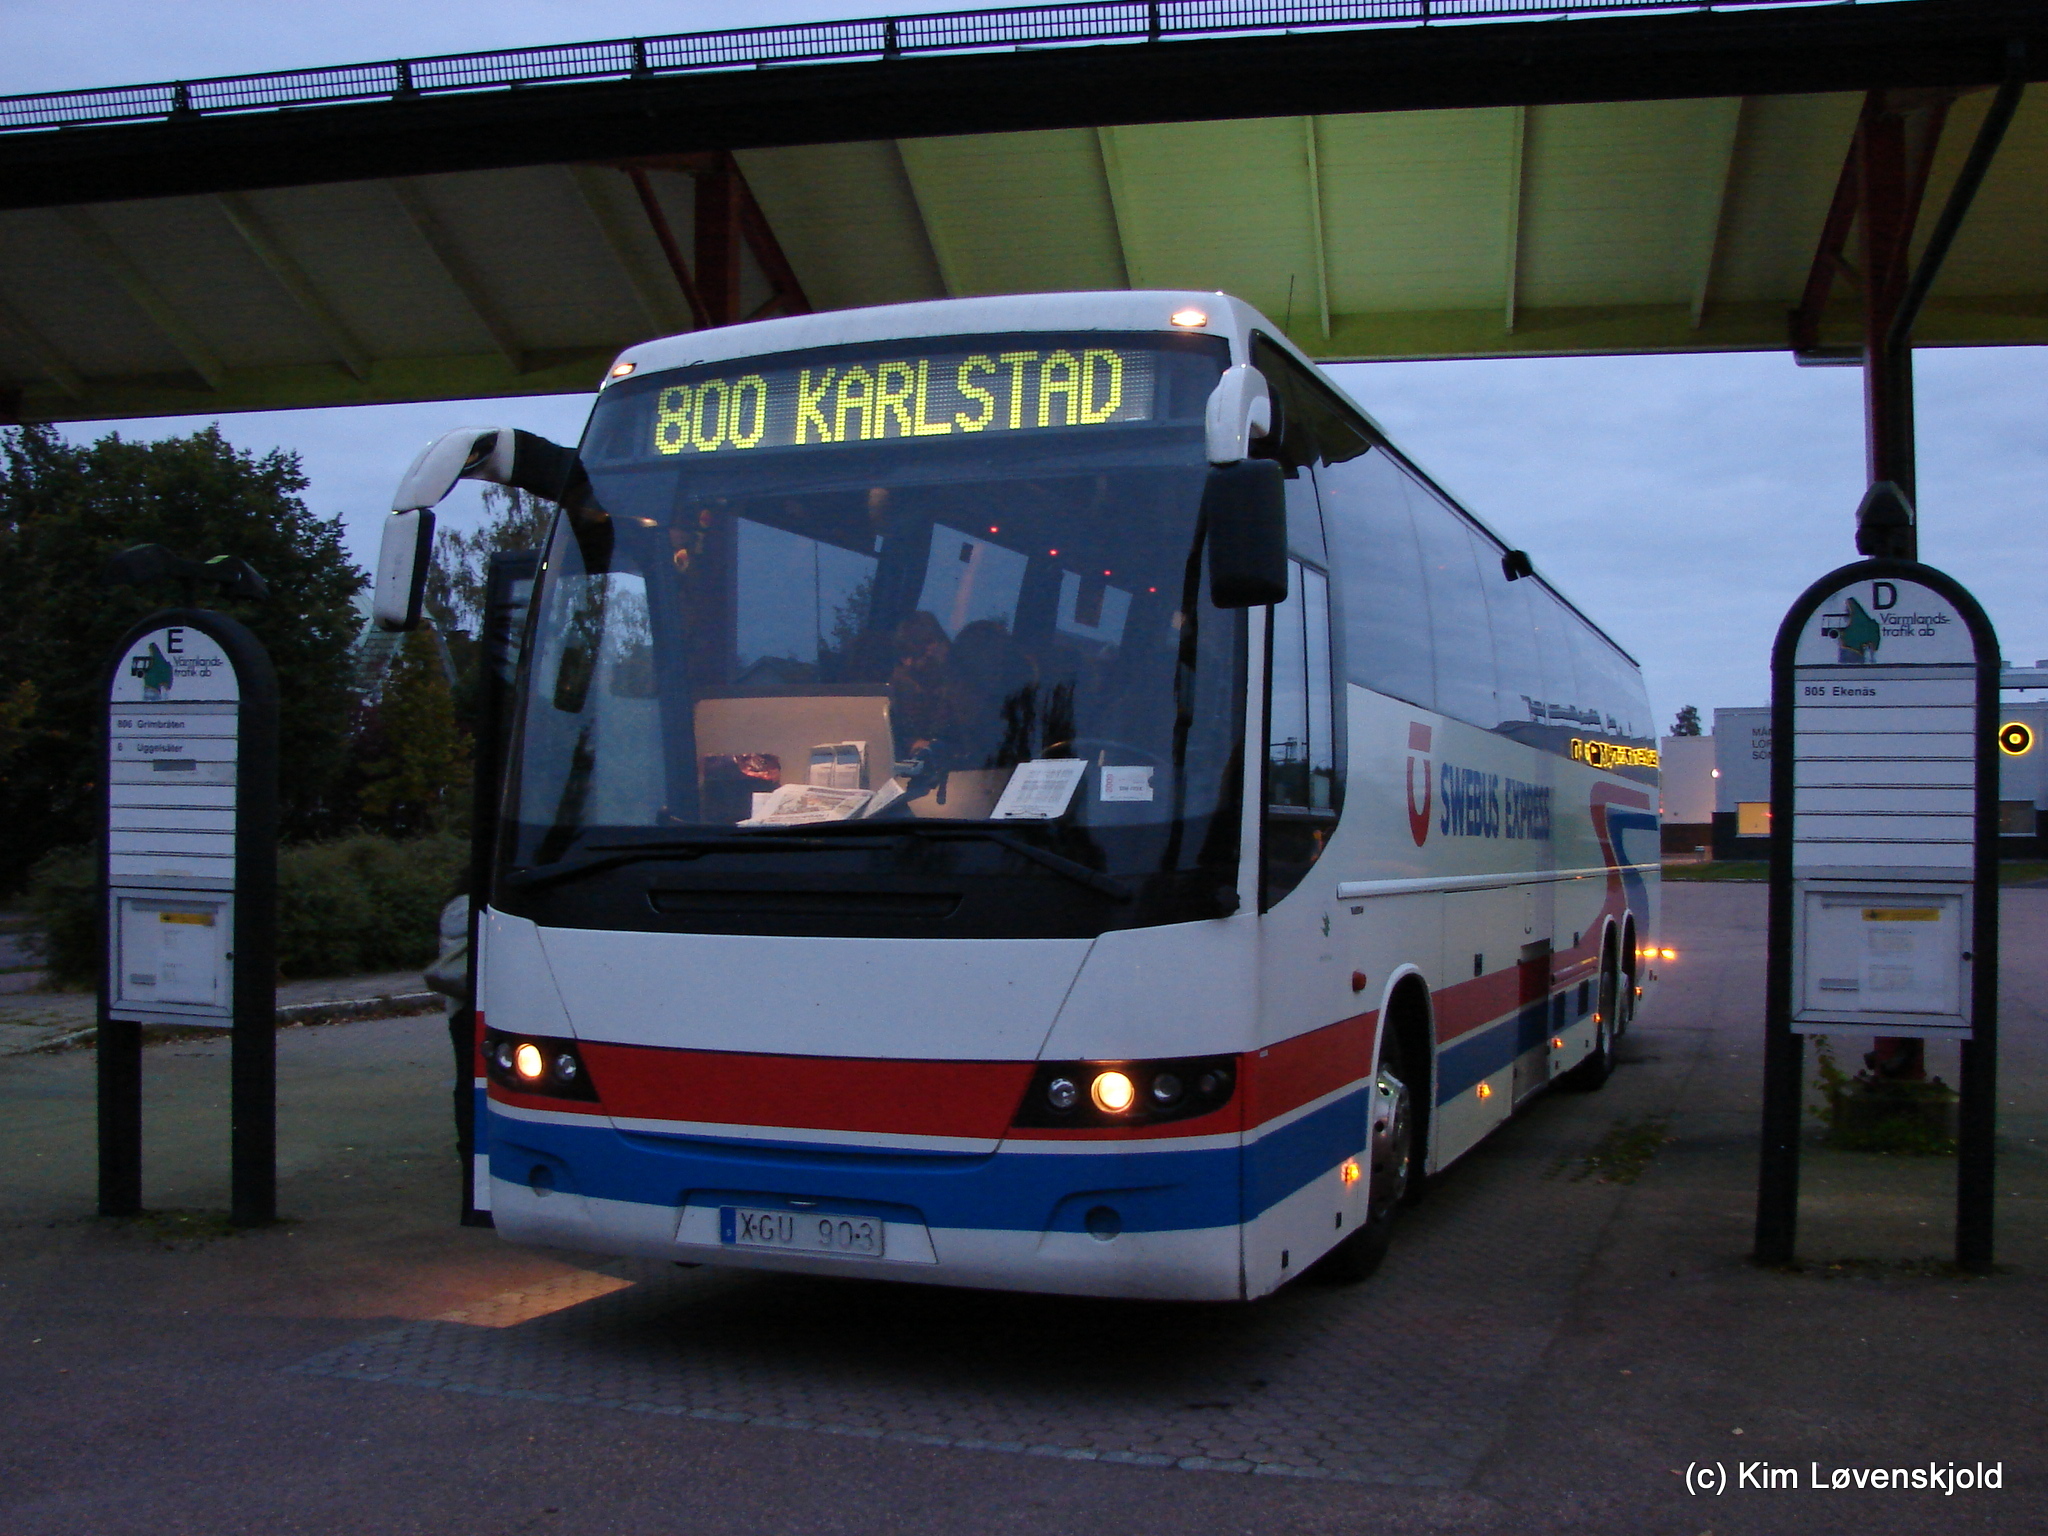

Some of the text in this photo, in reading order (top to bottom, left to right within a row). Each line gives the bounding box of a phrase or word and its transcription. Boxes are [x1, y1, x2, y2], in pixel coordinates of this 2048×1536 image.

[655, 348, 1122, 456] 800 KARLSTAD
[1872, 581, 1898, 610] D
[1879, 612, 1951, 624] Värmlands-
[1882, 625, 1935, 637] trafik ab
[167, 628, 184, 654] E
[199, 667, 212, 677] ab
[1804, 686, 1877, 697] 805 Ekenäs
[1440, 762, 1499, 837] SWEBUS
[741, 1212, 874, 1251] XGU 903
